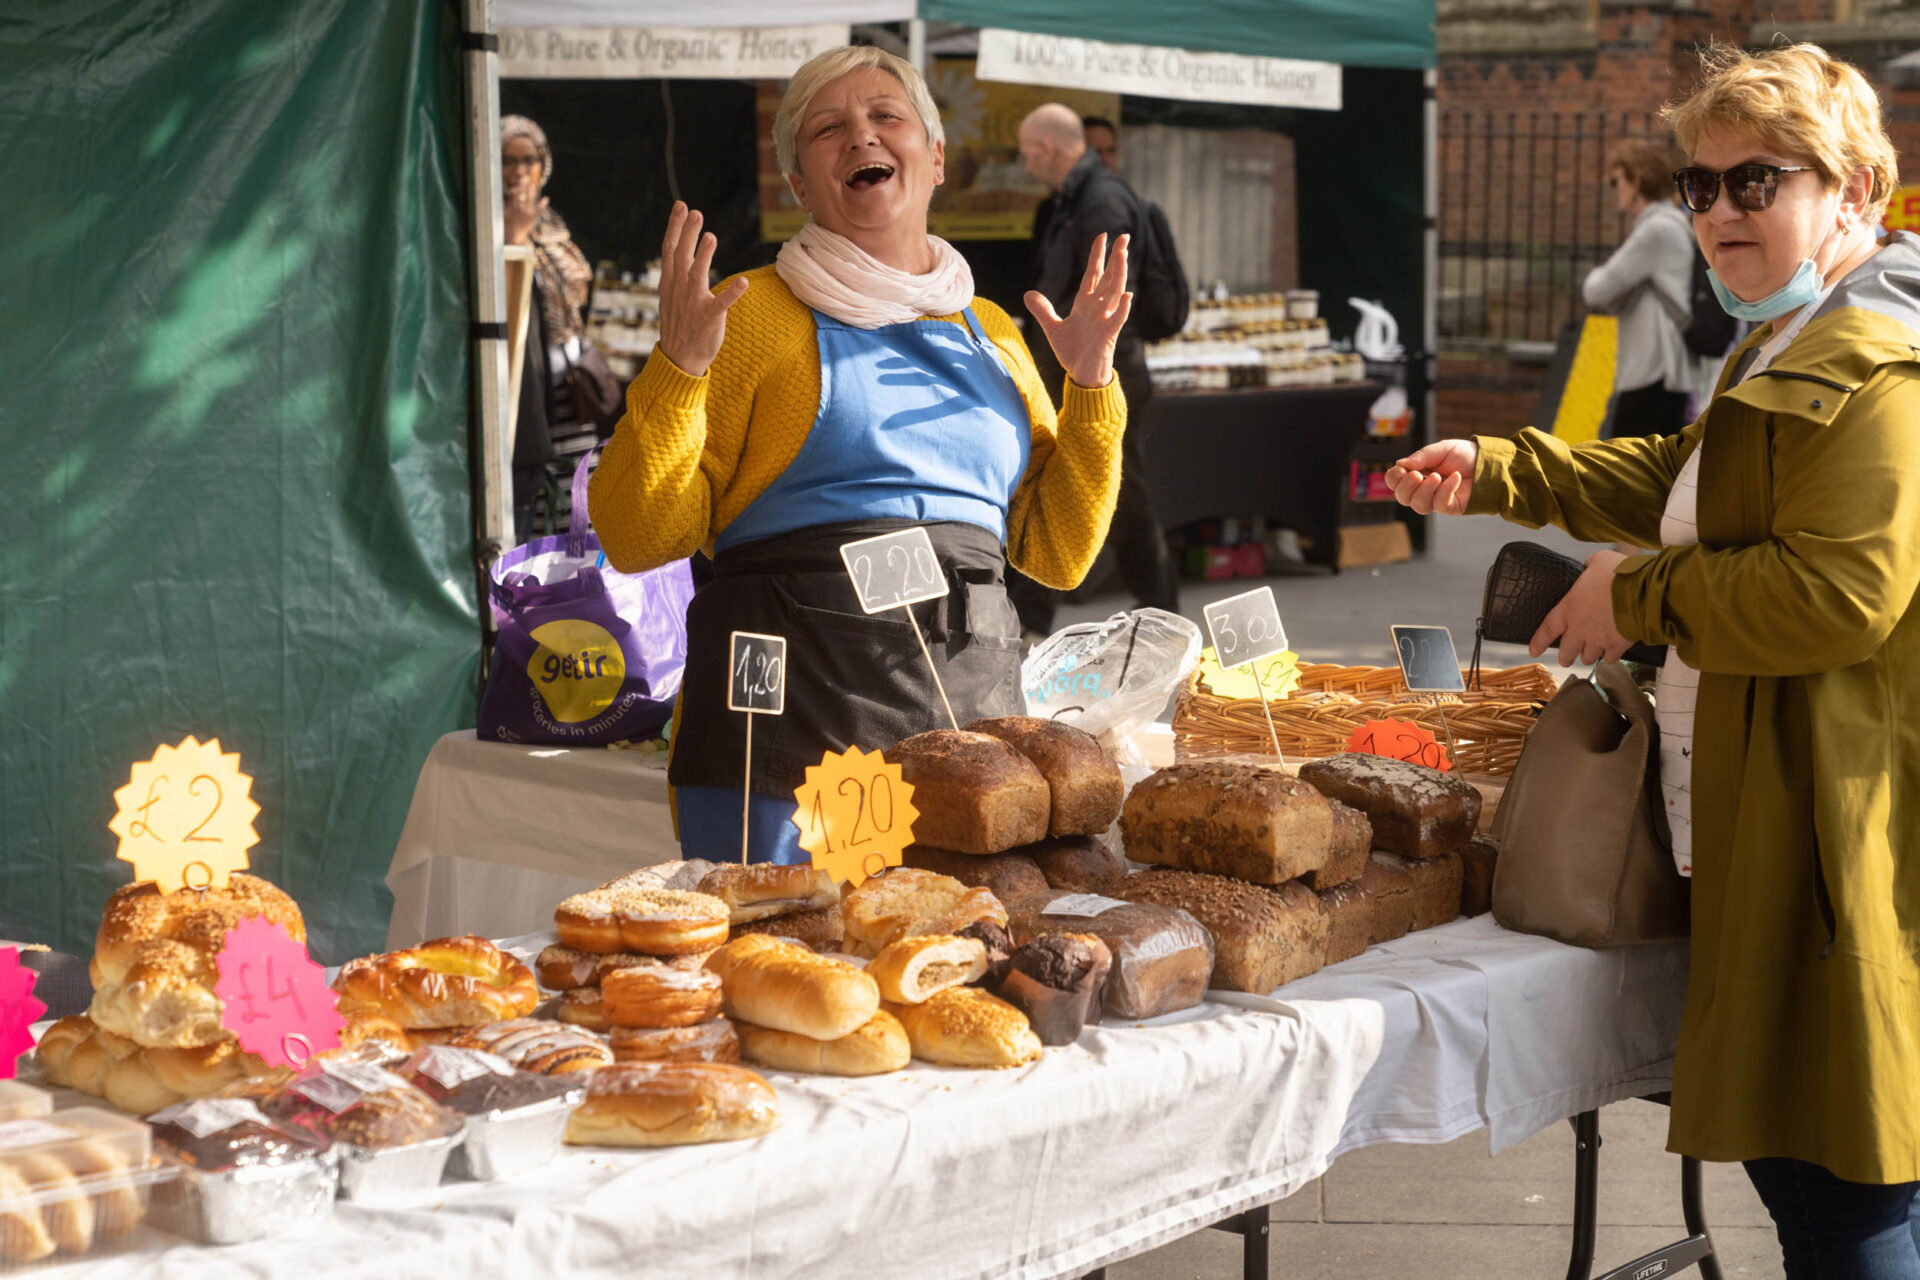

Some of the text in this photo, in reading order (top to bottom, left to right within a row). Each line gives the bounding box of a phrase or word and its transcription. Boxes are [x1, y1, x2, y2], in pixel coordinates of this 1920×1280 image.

[546, 30, 599, 60] Pure
[606, 29, 631, 60] &
[634, 30, 726, 69] Organic
[738, 29, 819, 62] Honey
[1014, 31, 1319, 100] 100% Pure & Organic Honey
[541, 650, 607, 683] getir
[570, 726, 586, 737] in
[588, 690, 638, 735] minutes
[238, 954, 309, 1024] £4
